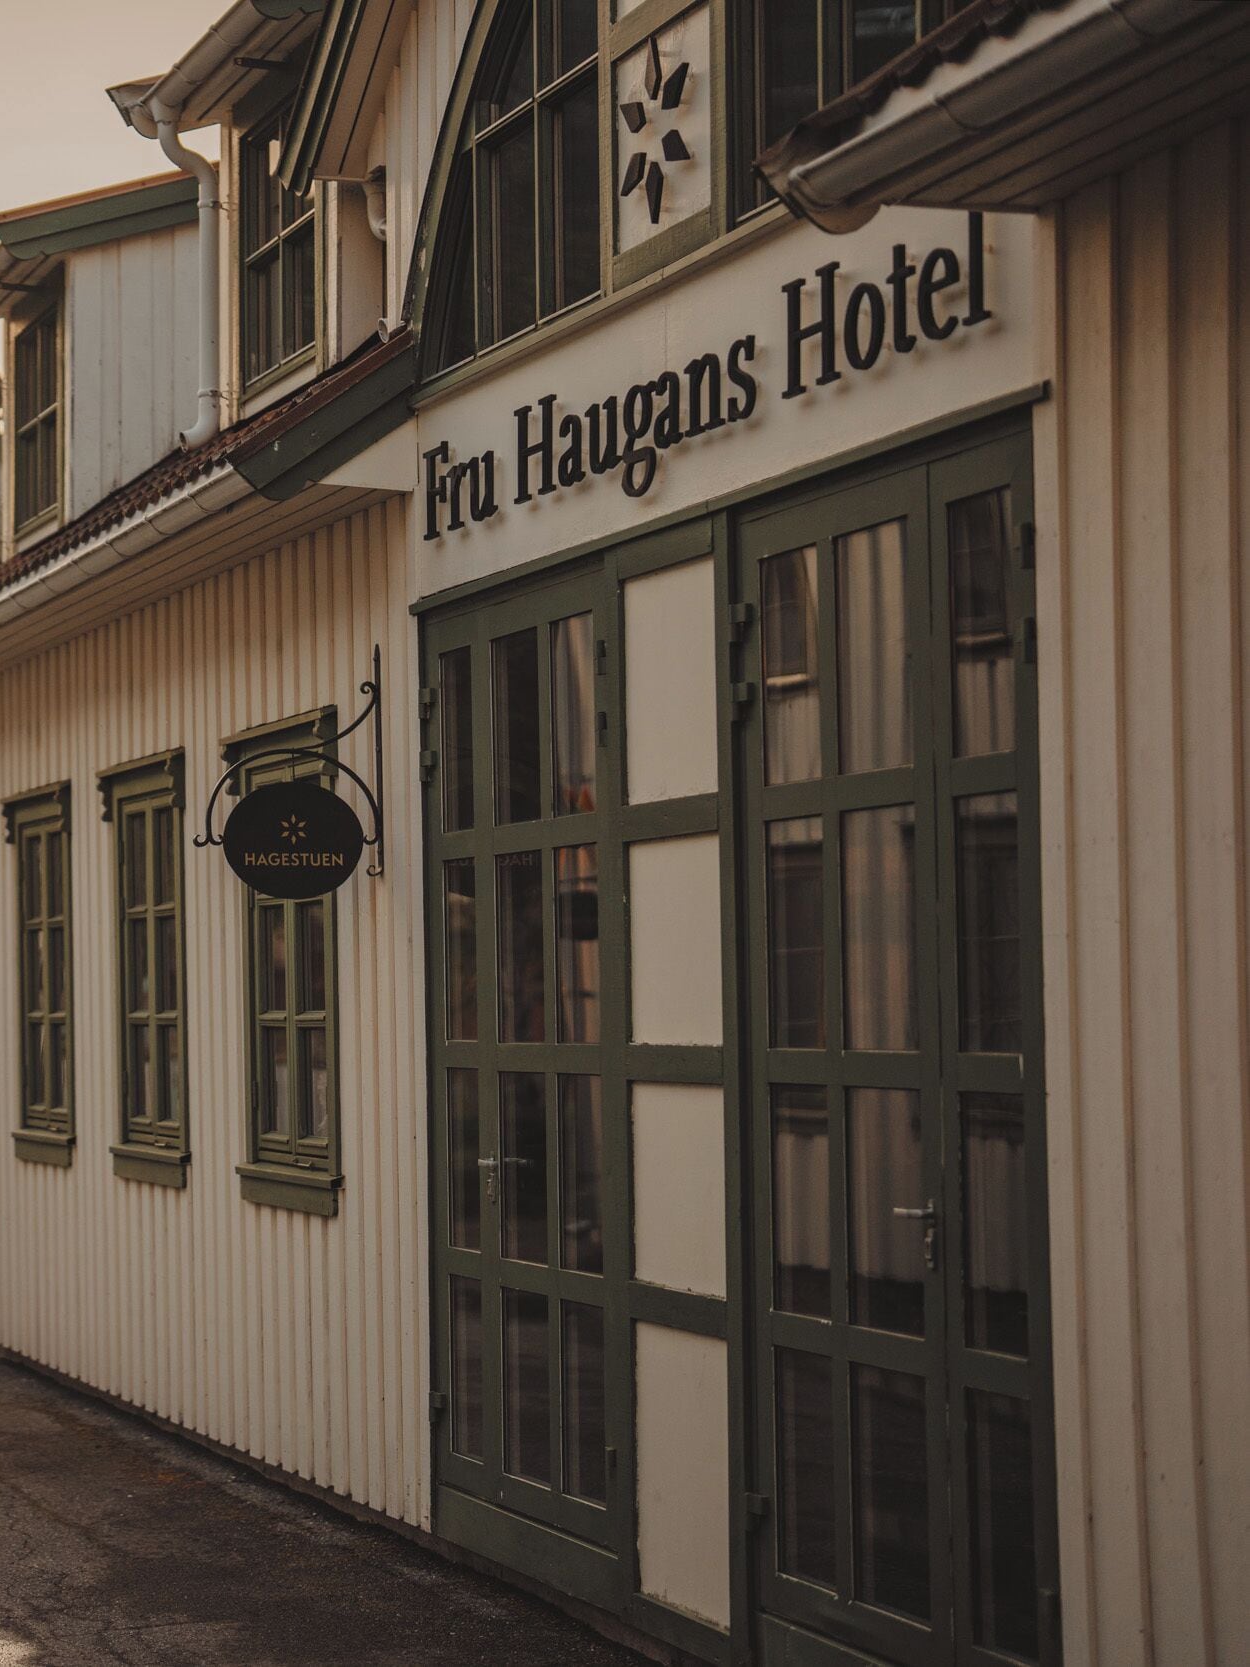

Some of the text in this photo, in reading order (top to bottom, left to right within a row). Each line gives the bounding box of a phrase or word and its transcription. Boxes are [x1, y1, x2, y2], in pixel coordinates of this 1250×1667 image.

[423, 211, 993, 541] Fru Haugans Hotel
[244, 852, 344, 867] HAGESTUEN
